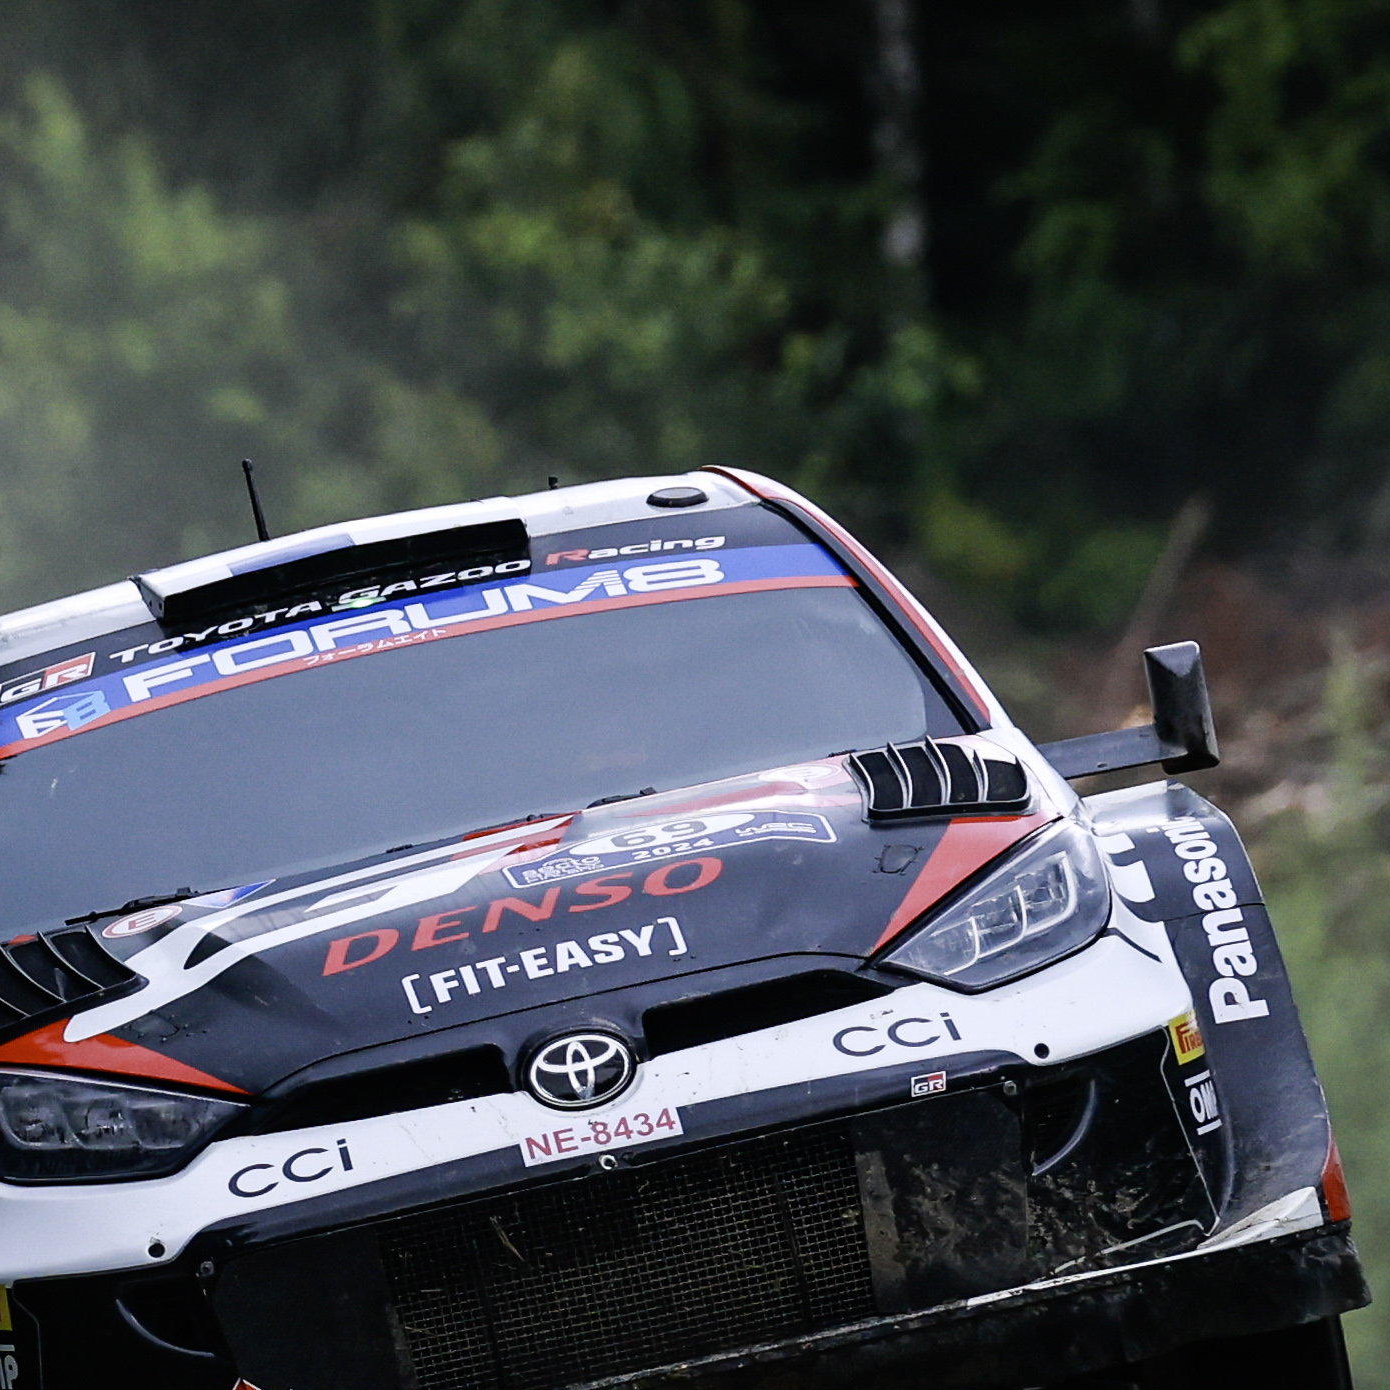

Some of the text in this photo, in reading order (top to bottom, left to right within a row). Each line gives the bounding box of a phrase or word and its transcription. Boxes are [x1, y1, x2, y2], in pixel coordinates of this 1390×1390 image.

[109, 600, 323, 664] TOYOTA
[337, 559, 532, 606] GAZOO
[545, 535, 726, 566] Racing
[121, 558, 725, 703] FORUM8
[302, 629, 447, 665] フォーラムエイト
[631, 838, 715, 861] 2024
[320, 856, 724, 977] DENSO
[913, 1076, 944, 1095] GR
[524, 1107, 677, 1160] NE-8434
